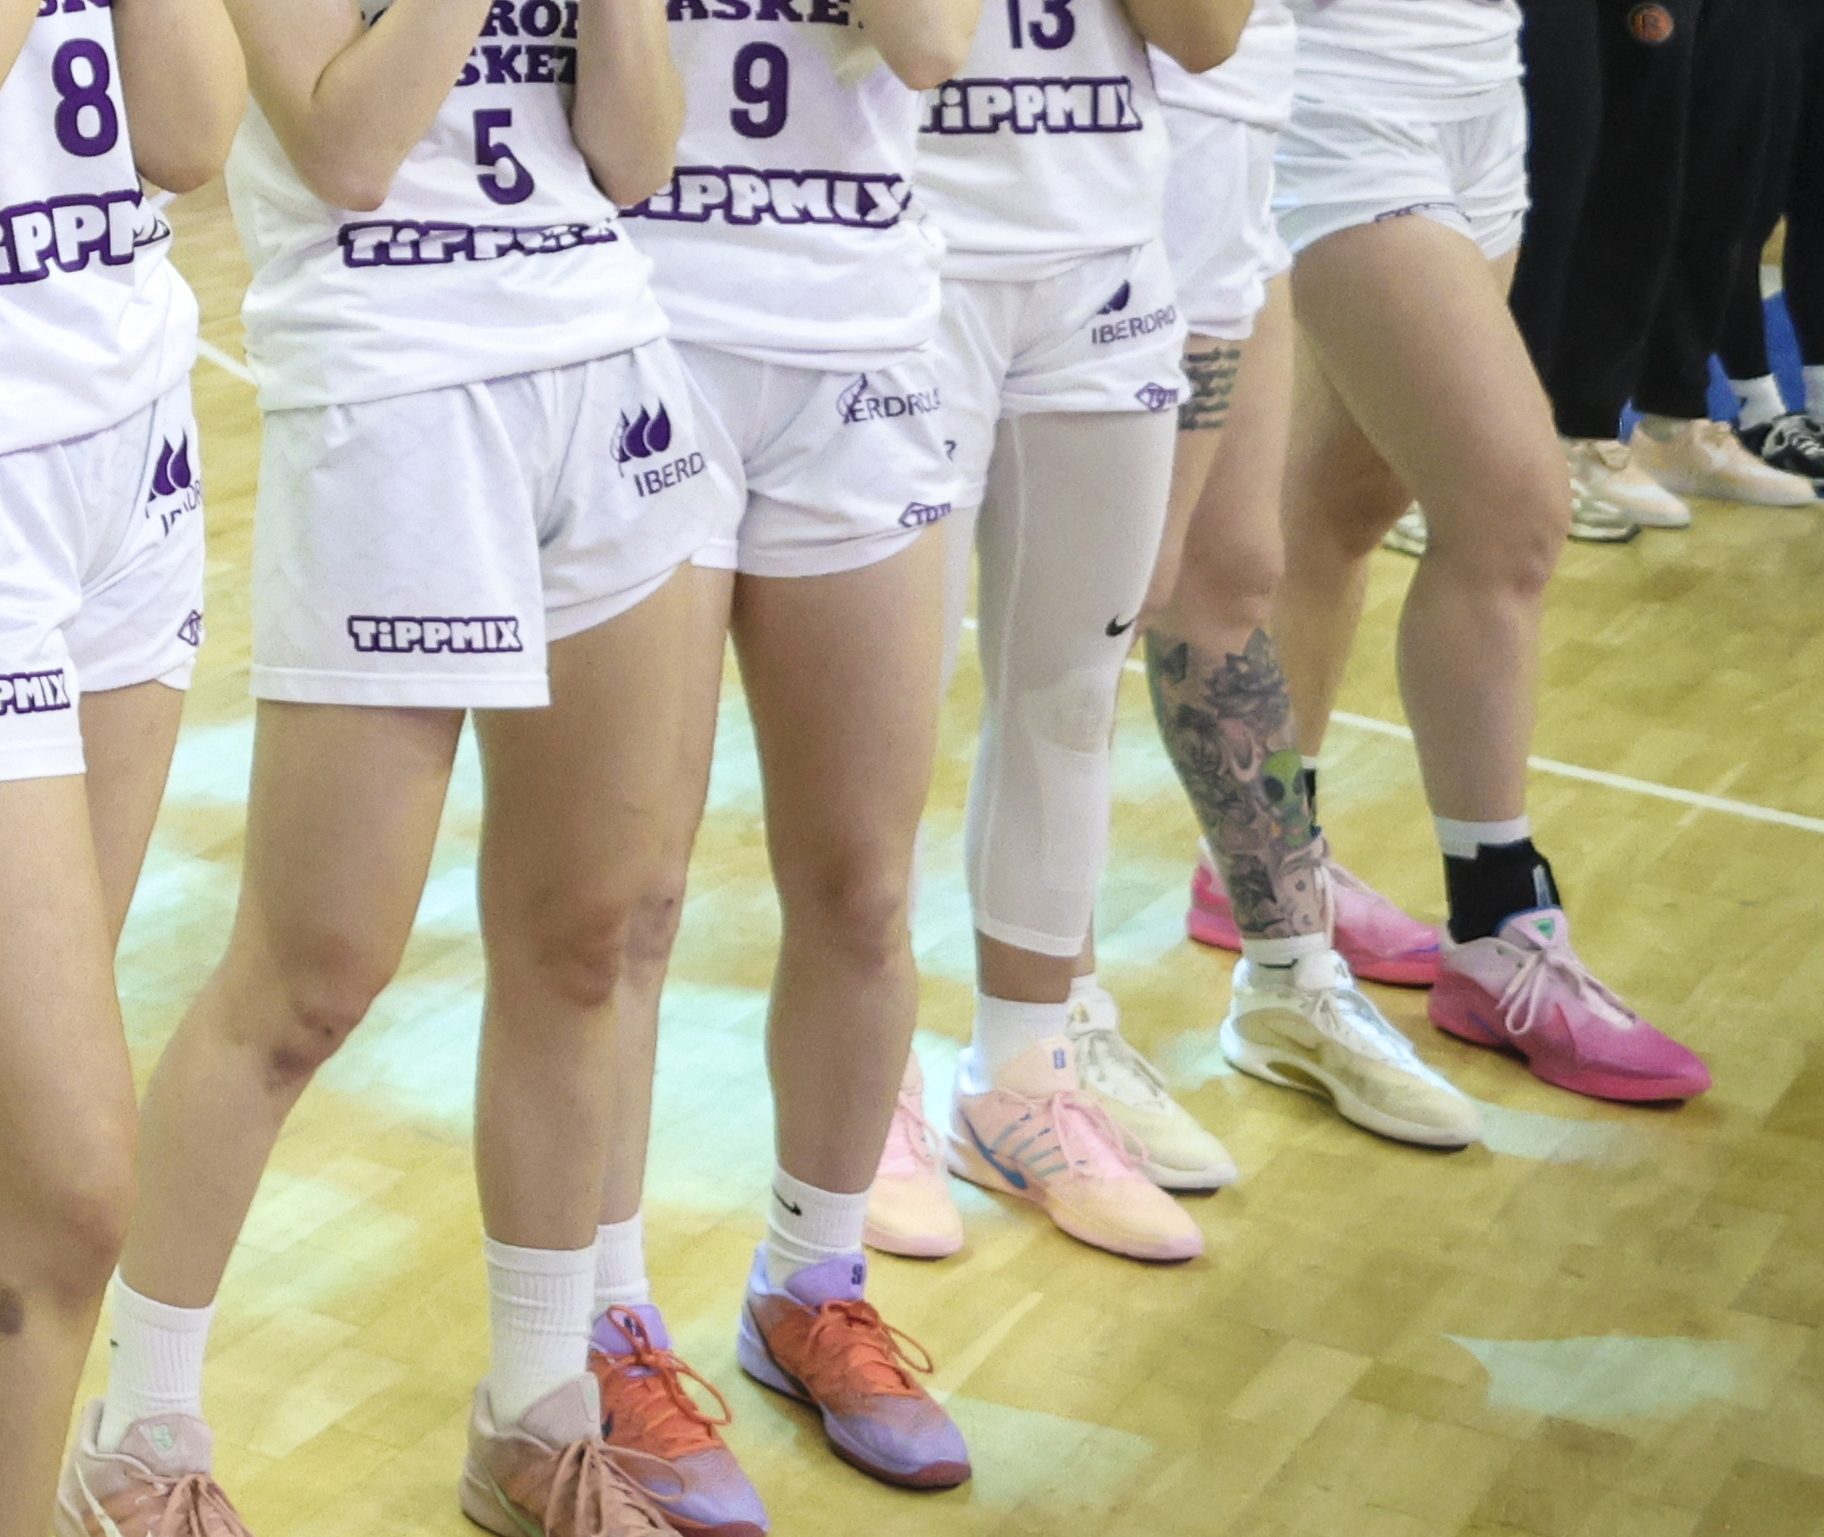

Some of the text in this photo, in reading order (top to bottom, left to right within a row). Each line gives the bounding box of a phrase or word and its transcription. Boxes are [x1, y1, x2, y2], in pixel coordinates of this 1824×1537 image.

[51, 38, 119, 157] 8
[729, 41, 790, 139] 9
[473, 108, 535, 205] 5
[1091, 305, 1177, 345] IBERDRO
[634, 452, 707, 498] IBERD
